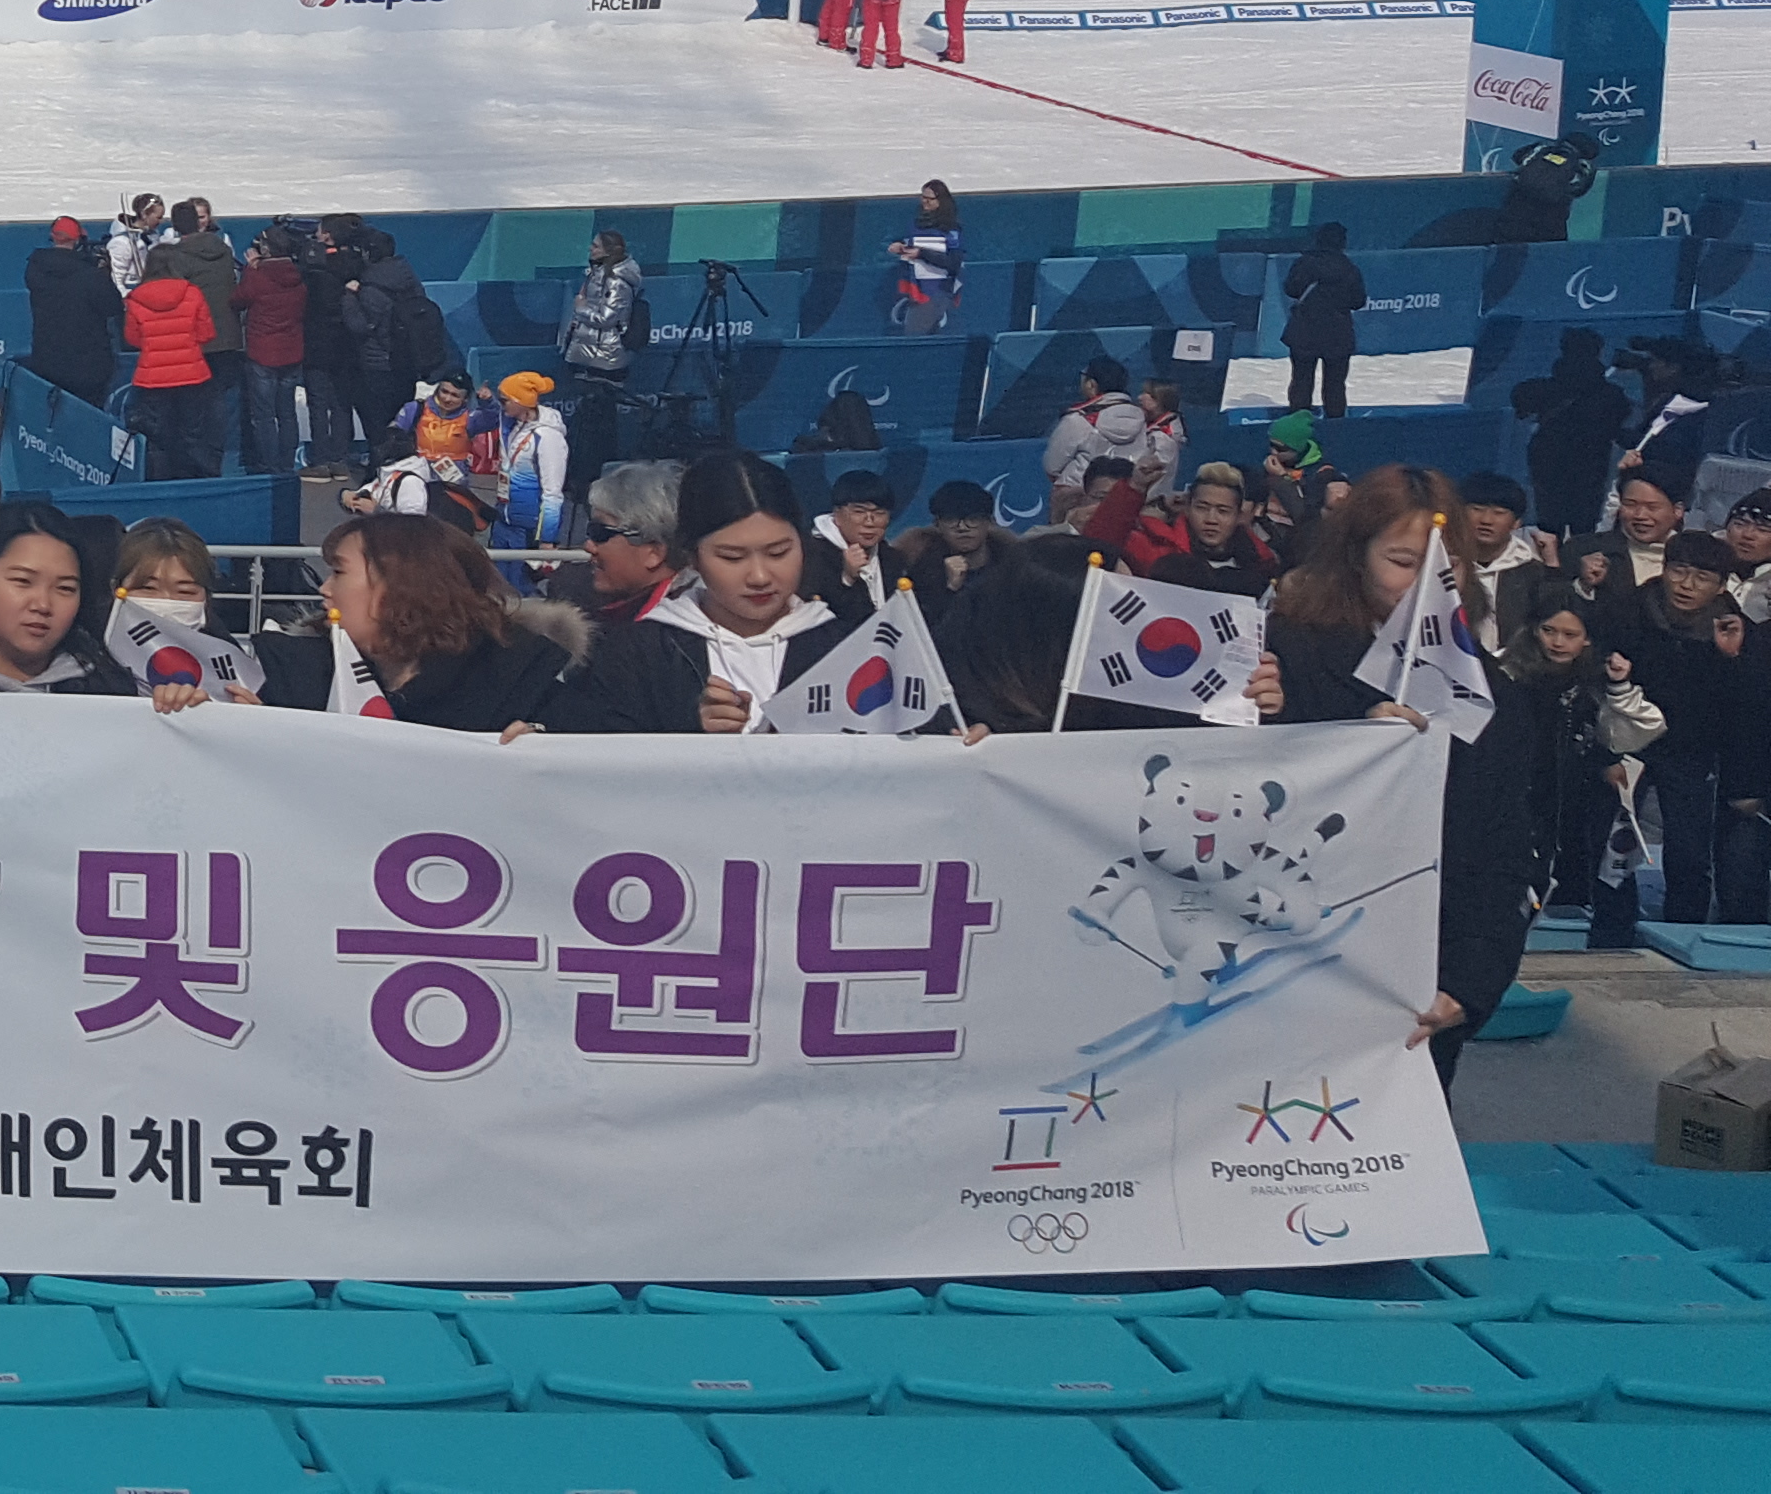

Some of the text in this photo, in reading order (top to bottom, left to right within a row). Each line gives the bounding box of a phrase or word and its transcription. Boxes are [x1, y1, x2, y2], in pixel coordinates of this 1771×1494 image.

[1165, 8, 1221, 22] Panasonic
[1237, 7, 1293, 17] Panasonic
[1309, 6, 1364, 17] Panasonic
[1379, 4, 1434, 13] Panasonic
[1018, 15, 1074, 25] Panasonic
[1092, 14, 1148, 25] Panasonic
[1404, 293, 1440, 310] 2018
[74, 849, 250, 1044] 및
[335, 831, 995, 1074] 응원단
[1211, 1157, 1350, 1182] PyeongChang
[960, 1182, 1088, 1209] PyeongChang
[1250, 1181, 1370, 1197] PARALYMPIC GAMES
